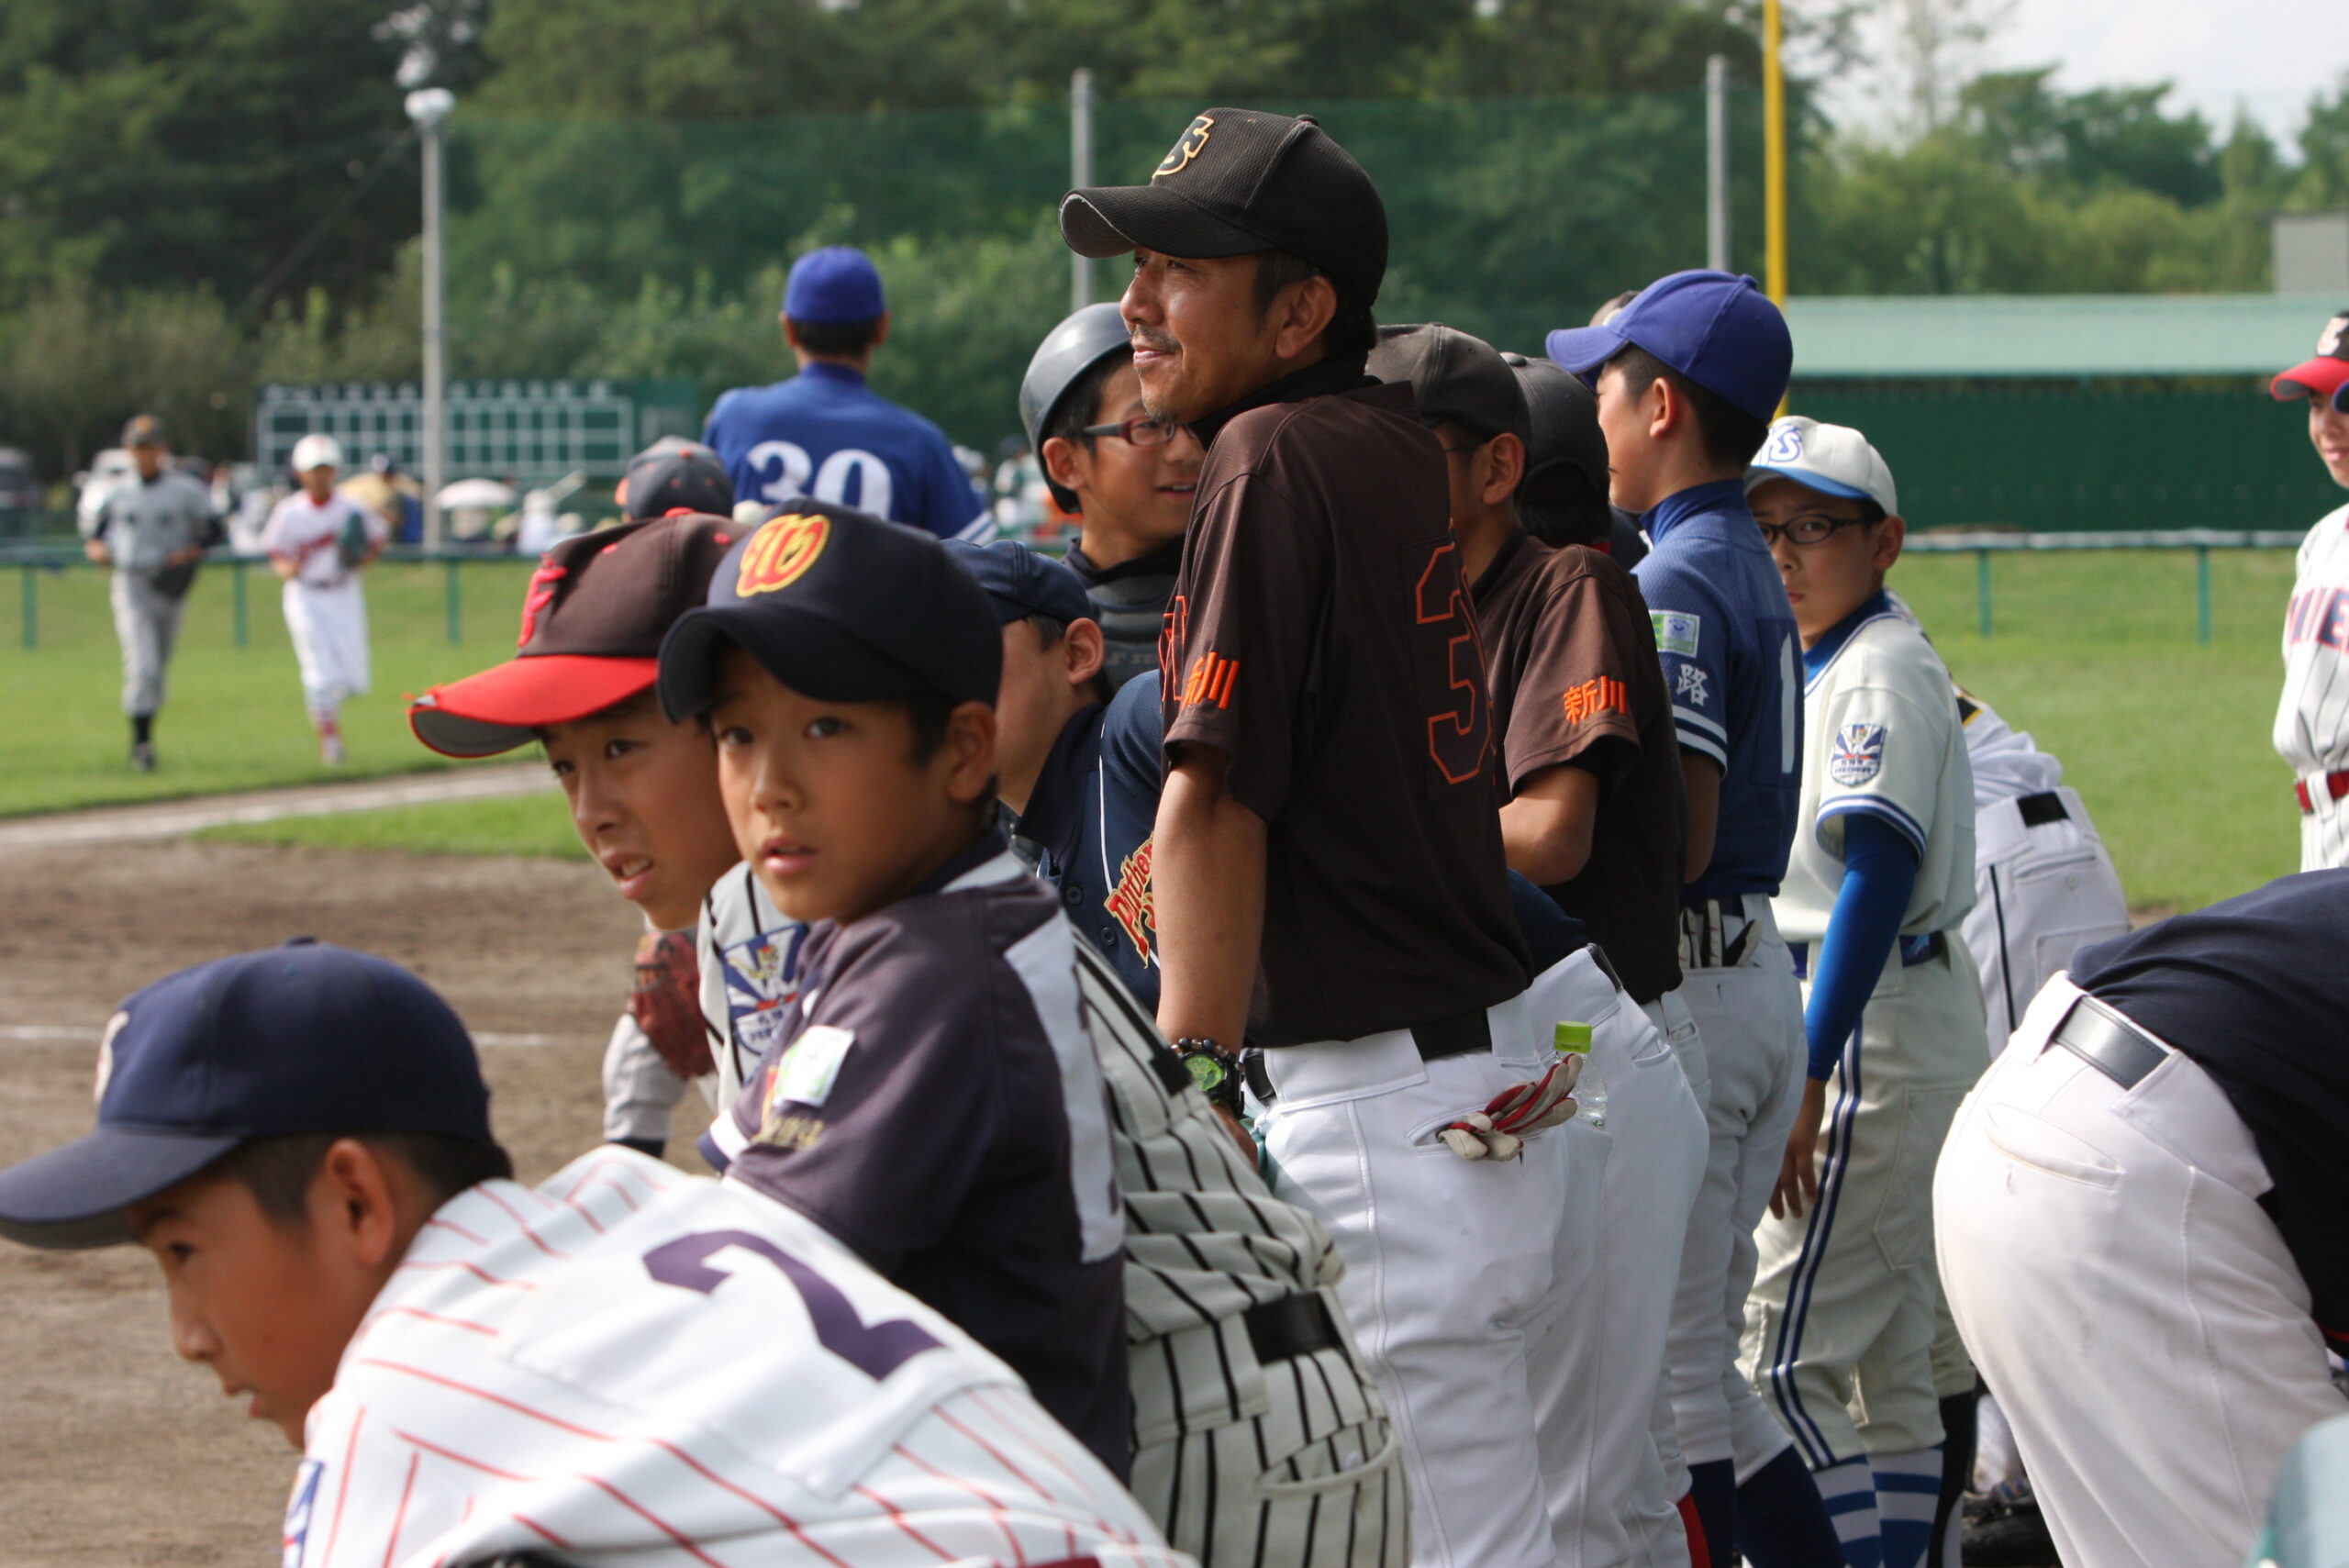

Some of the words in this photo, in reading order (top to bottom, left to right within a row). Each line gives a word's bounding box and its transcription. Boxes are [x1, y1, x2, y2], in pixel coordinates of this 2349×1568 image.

[1563, 674, 1627, 725] 新川
[1675, 662, 1709, 707] 路
[642, 1229, 952, 1383] 2
